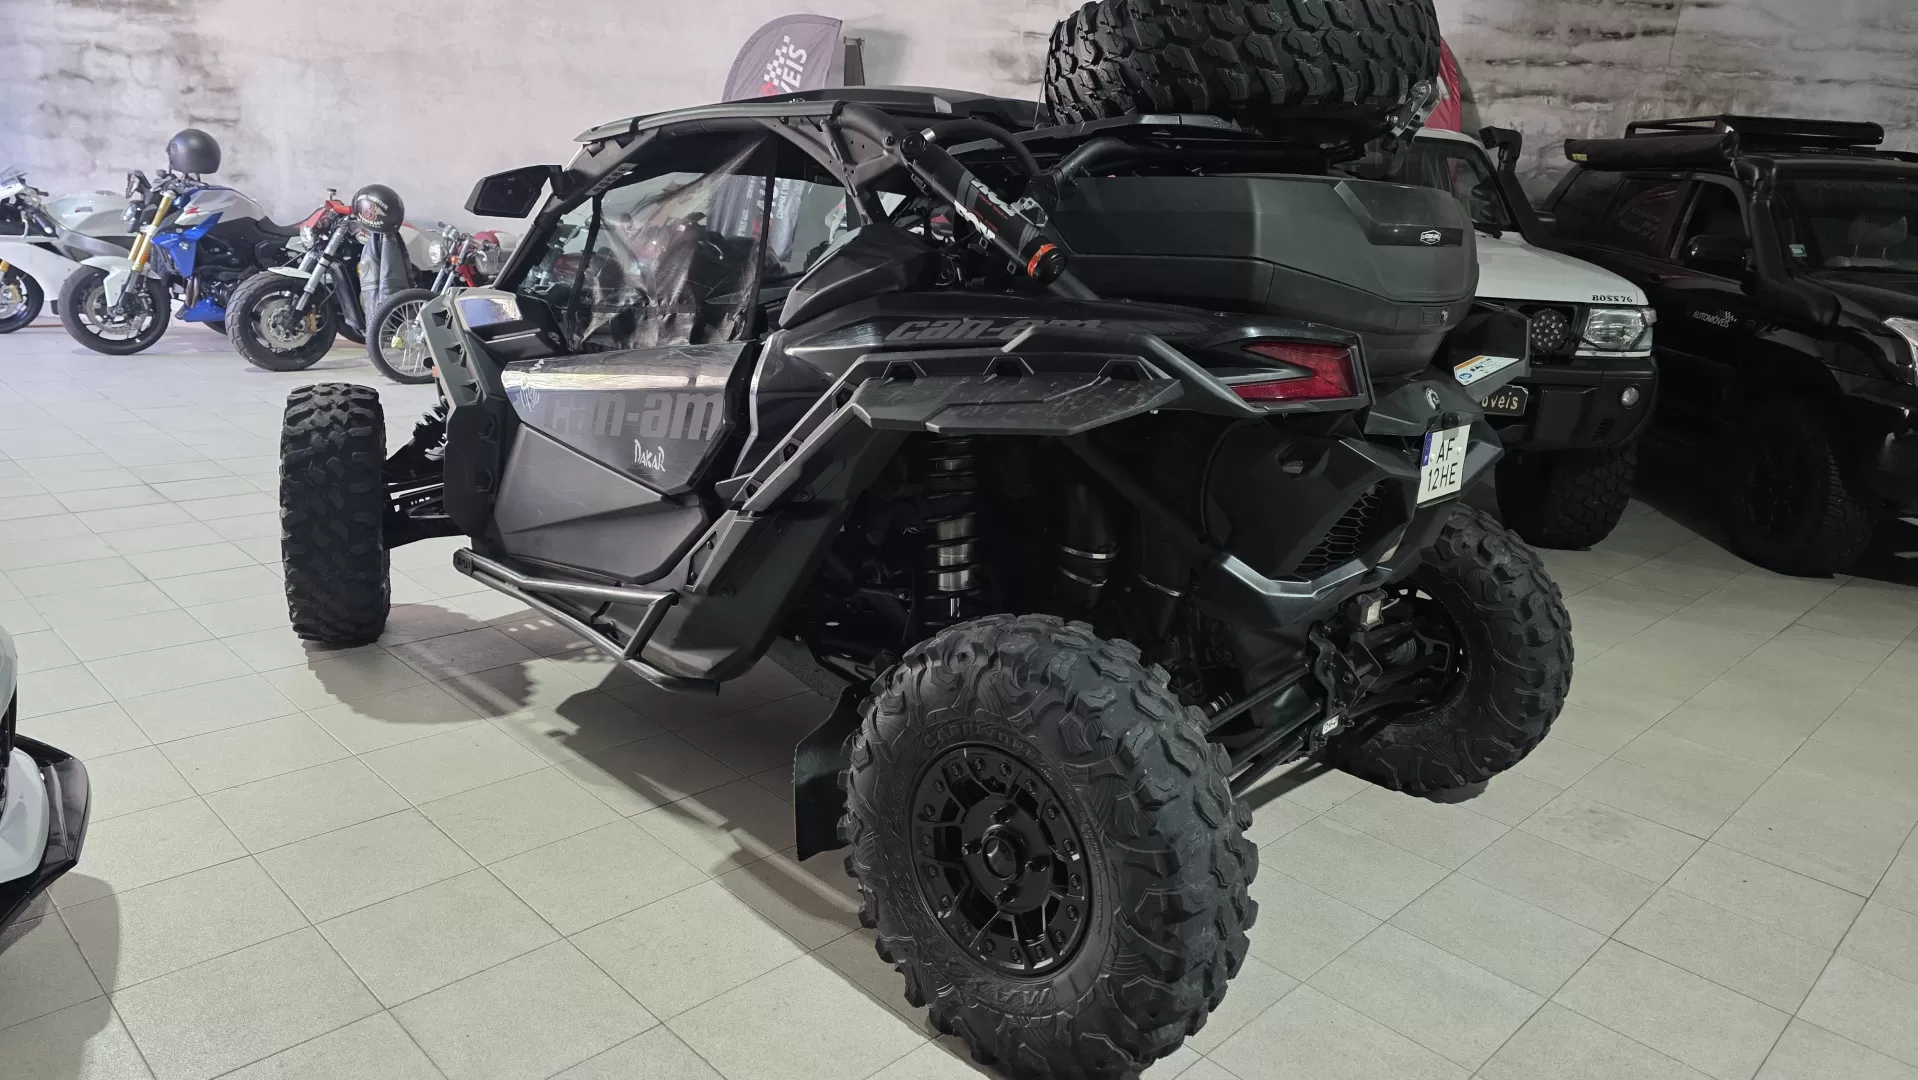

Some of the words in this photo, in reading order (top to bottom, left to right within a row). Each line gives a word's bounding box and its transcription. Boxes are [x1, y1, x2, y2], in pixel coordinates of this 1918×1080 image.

[634, 438, 666, 472] DAKAR
[1436, 437, 1456, 464] AF
[1428, 462, 1458, 492] 12HE
